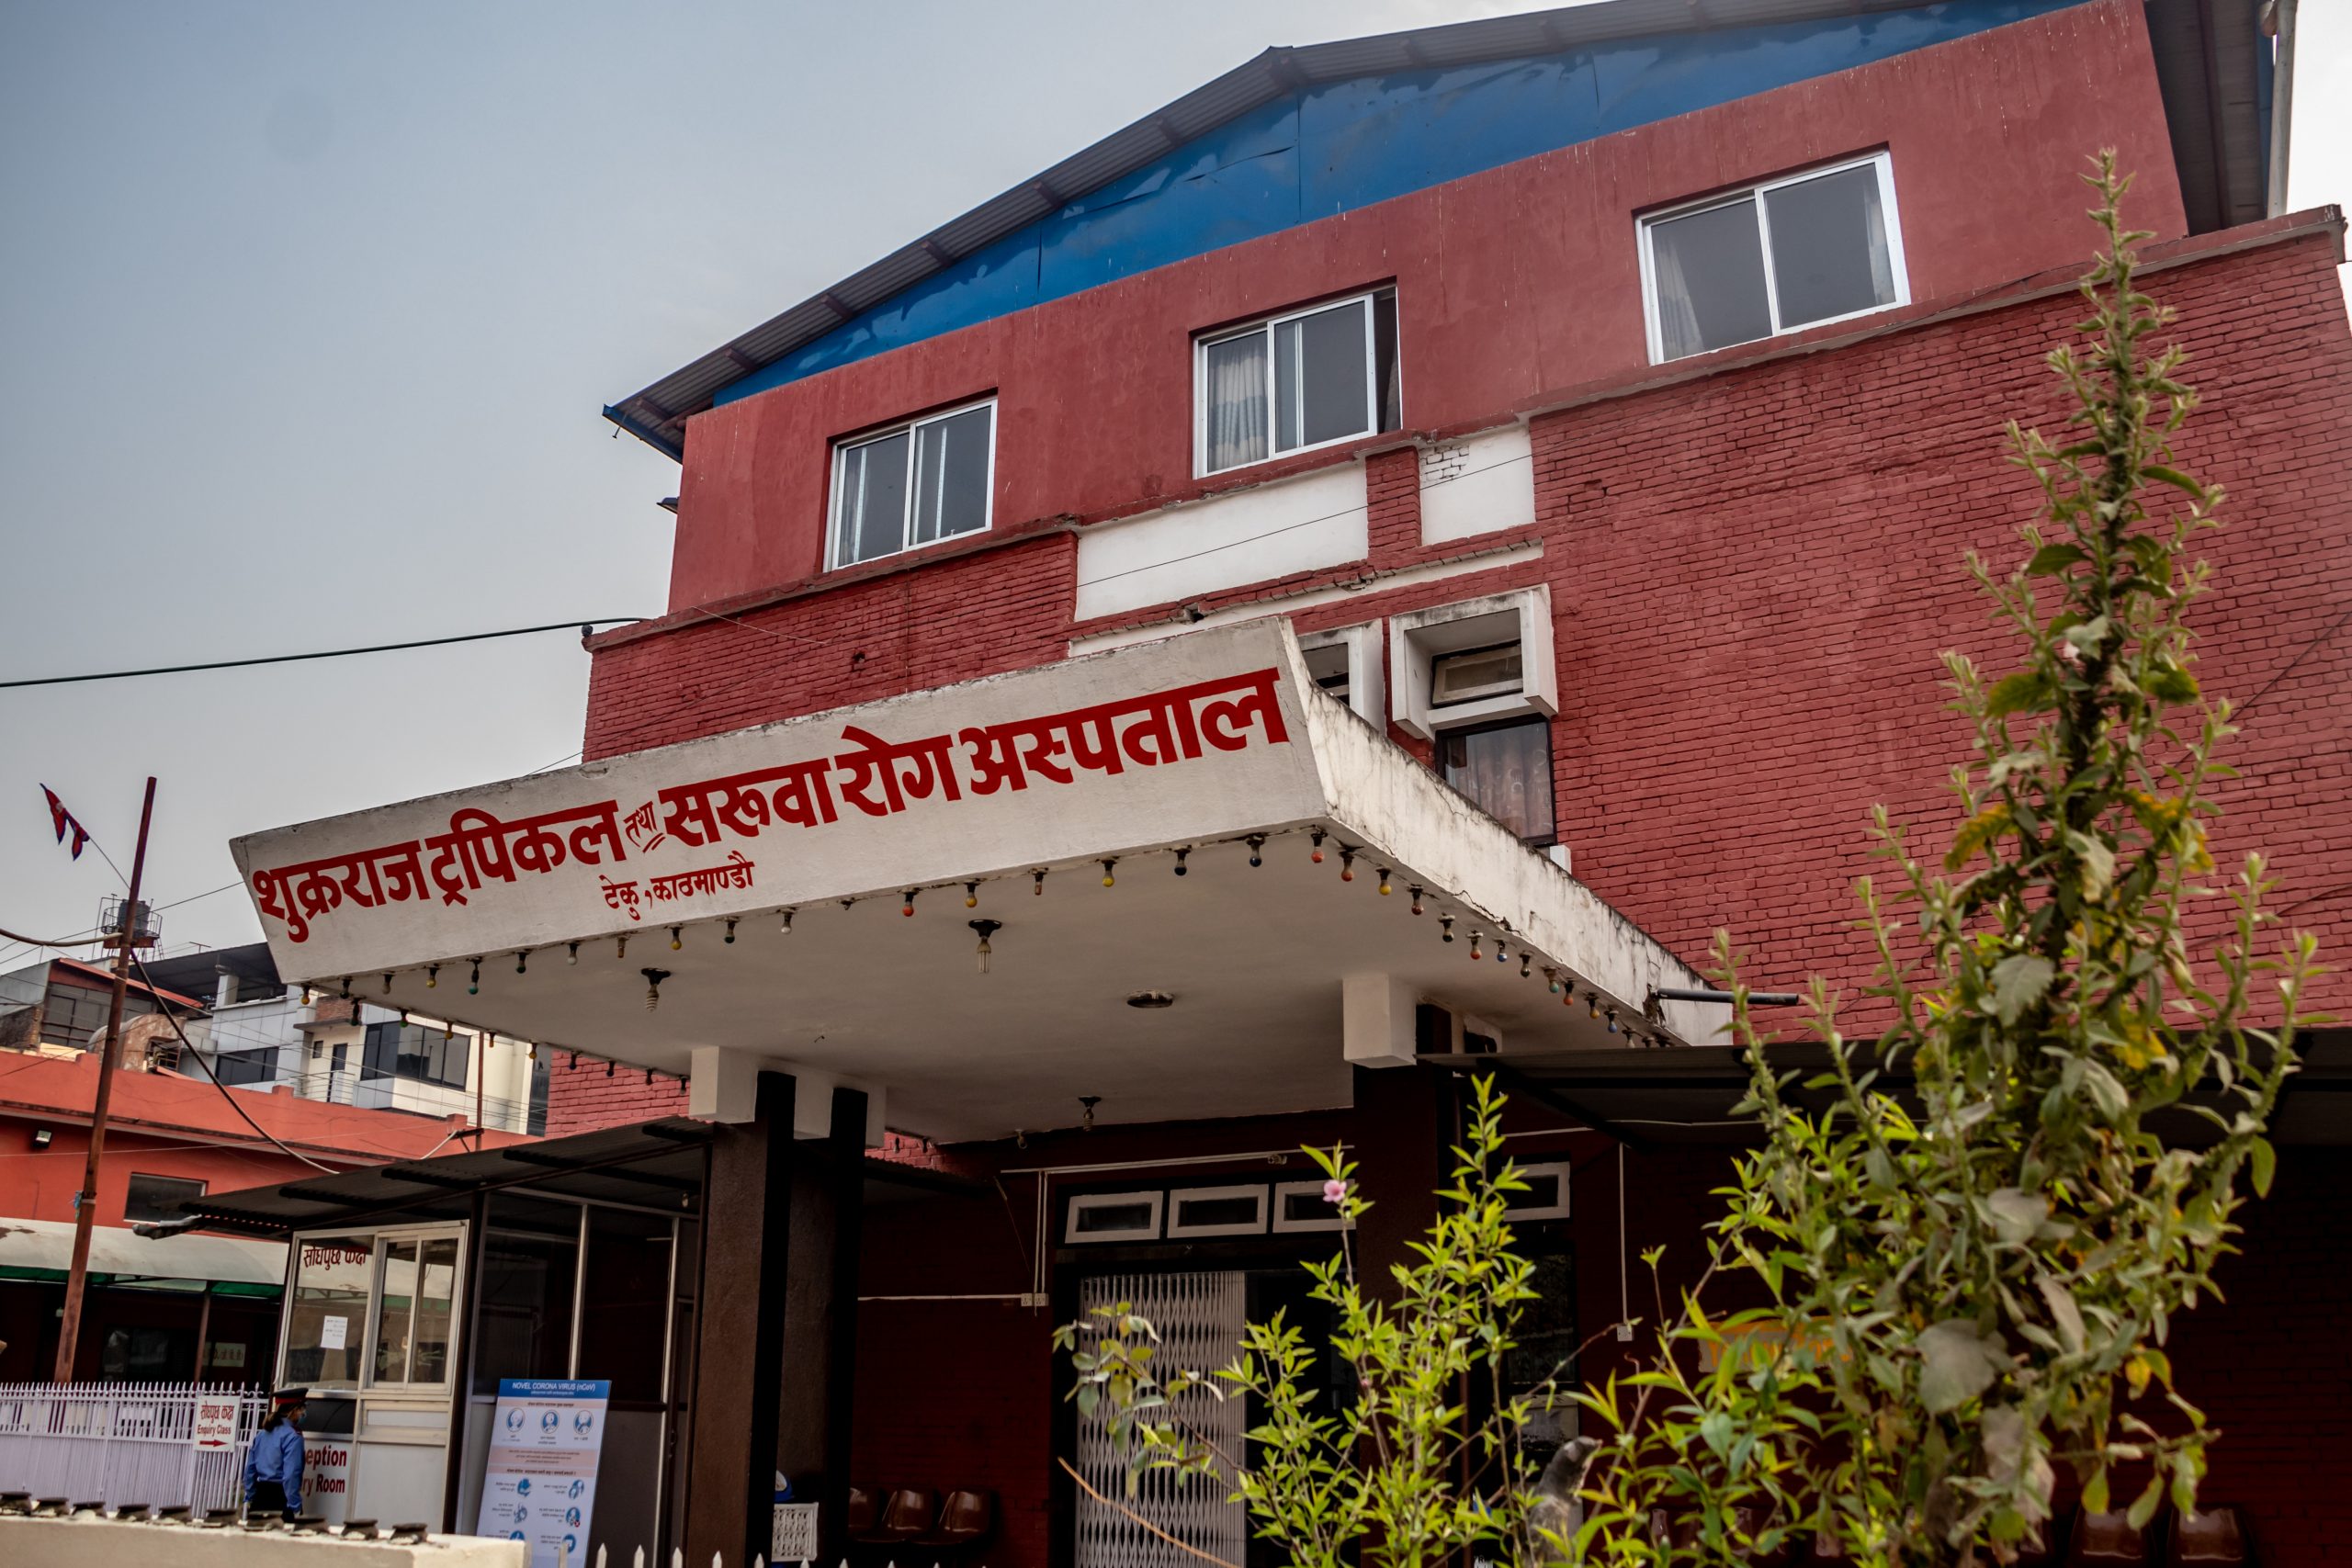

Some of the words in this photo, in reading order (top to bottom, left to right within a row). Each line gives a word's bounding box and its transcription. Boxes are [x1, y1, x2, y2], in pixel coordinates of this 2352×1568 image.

[253, 840, 431, 943] शुक्रराज
[424, 799, 627, 907] ट्रपिकल
[623, 801, 658, 848] तथा
[833, 725, 961, 817] रोग
[958, 667, 1290, 795] अस्पताल
[512, 1382, 532, 1390] NOVEL
[532, 1382, 558, 1391] CORONA
[559, 1382, 576, 1391] VIRUS
[197, 1424, 216, 1437] Enquiry
[305, 1444, 347, 1471] eption
[315, 1473, 345, 1494] Room
